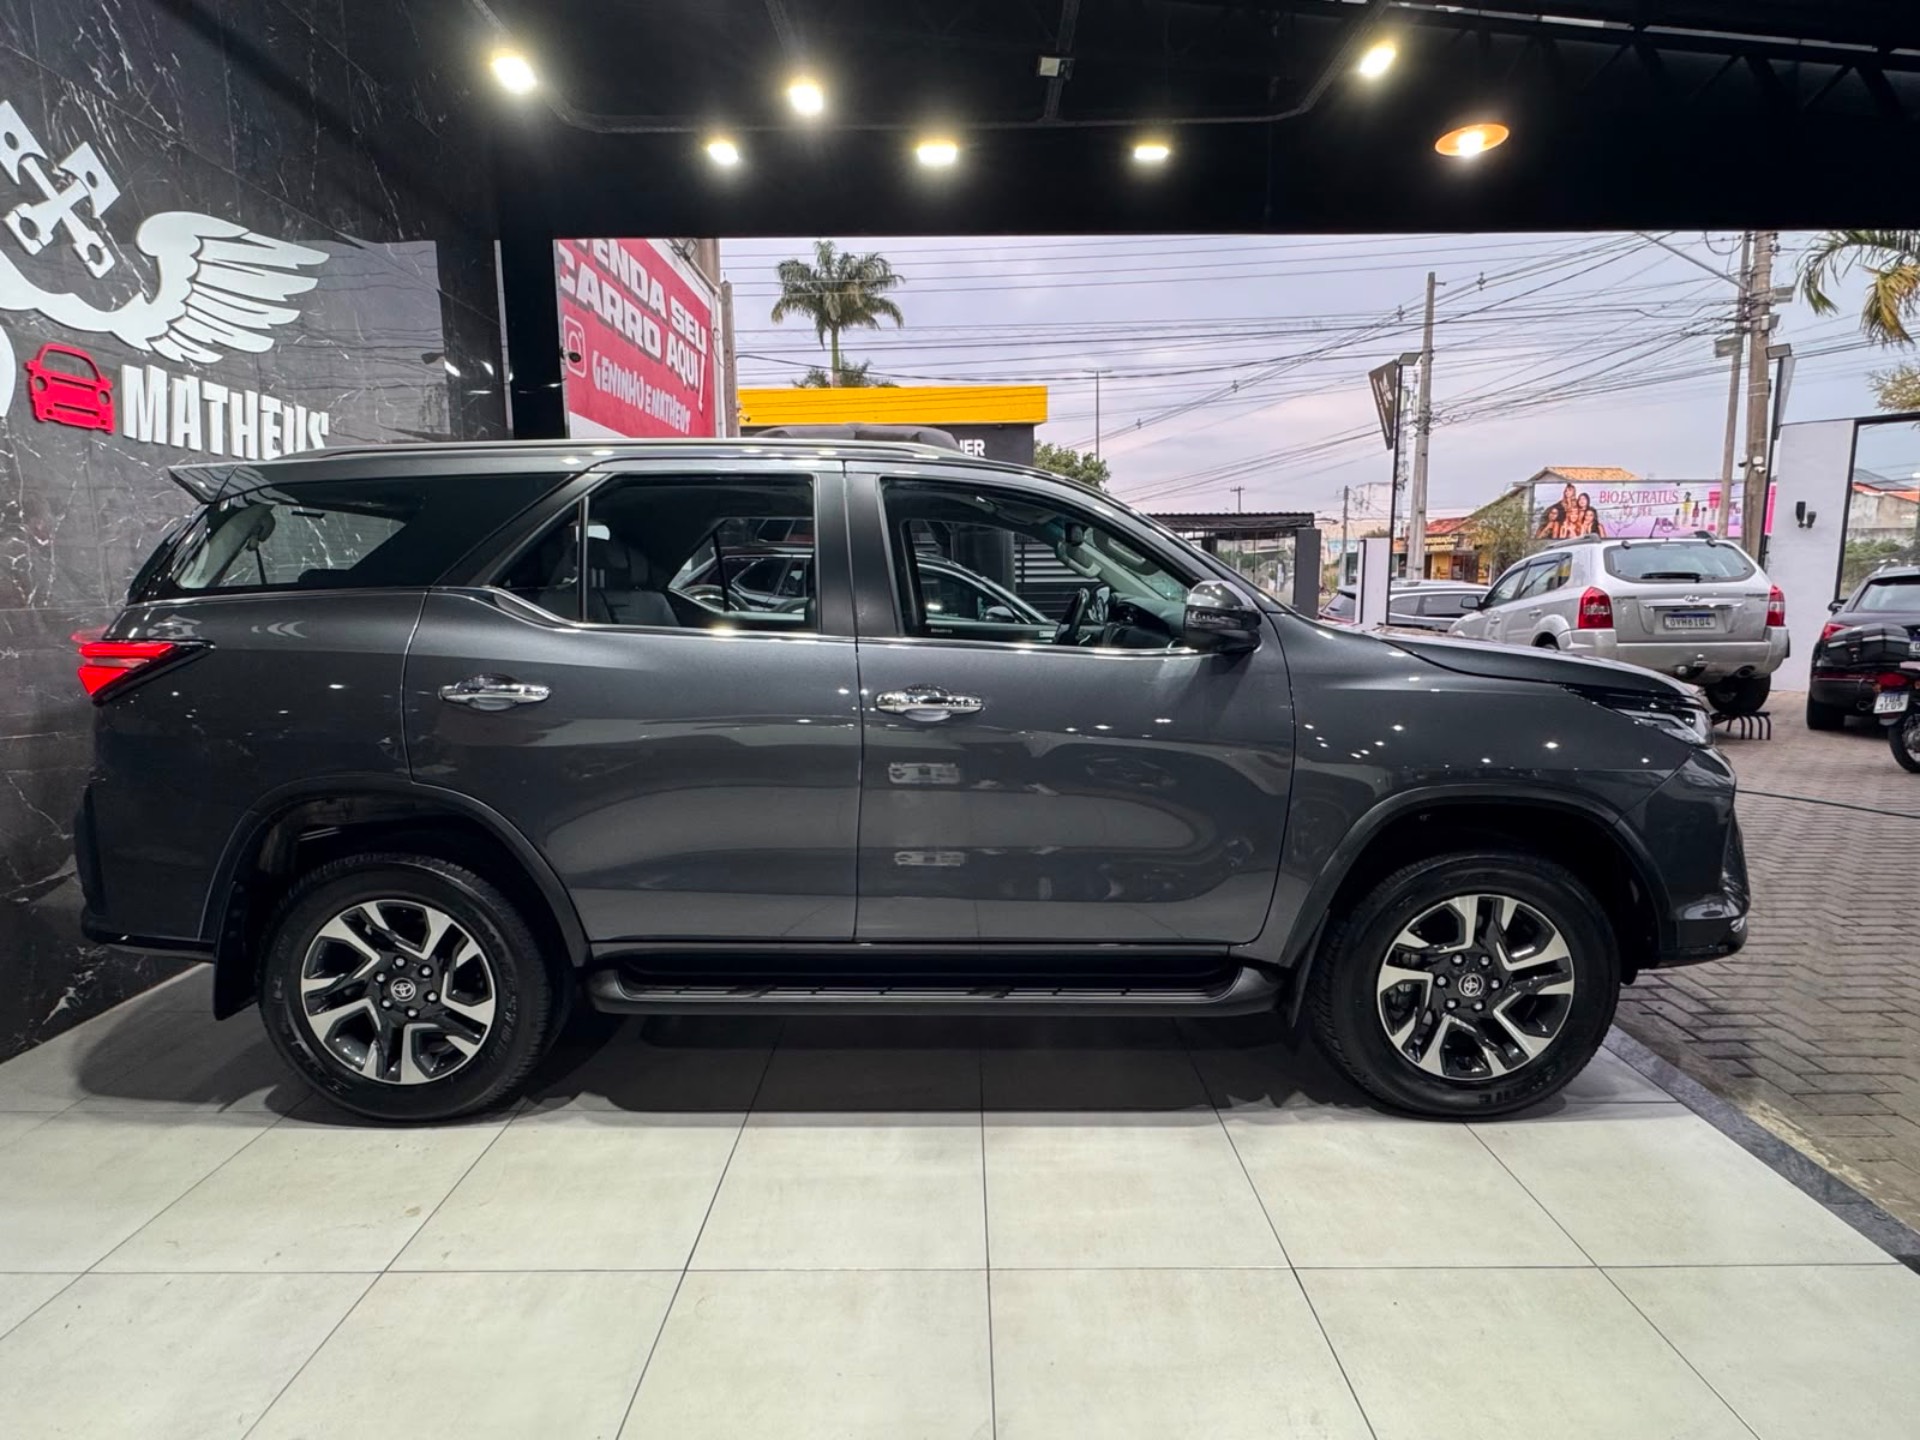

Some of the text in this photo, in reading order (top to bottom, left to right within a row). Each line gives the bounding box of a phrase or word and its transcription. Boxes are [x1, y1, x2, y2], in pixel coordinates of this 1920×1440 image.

[576, 239, 708, 355] ENDA SEU
[121, 364, 329, 460] MATHEUS
[666, 331, 706, 412] AQUI!
[960, 439, 985, 457] ER
